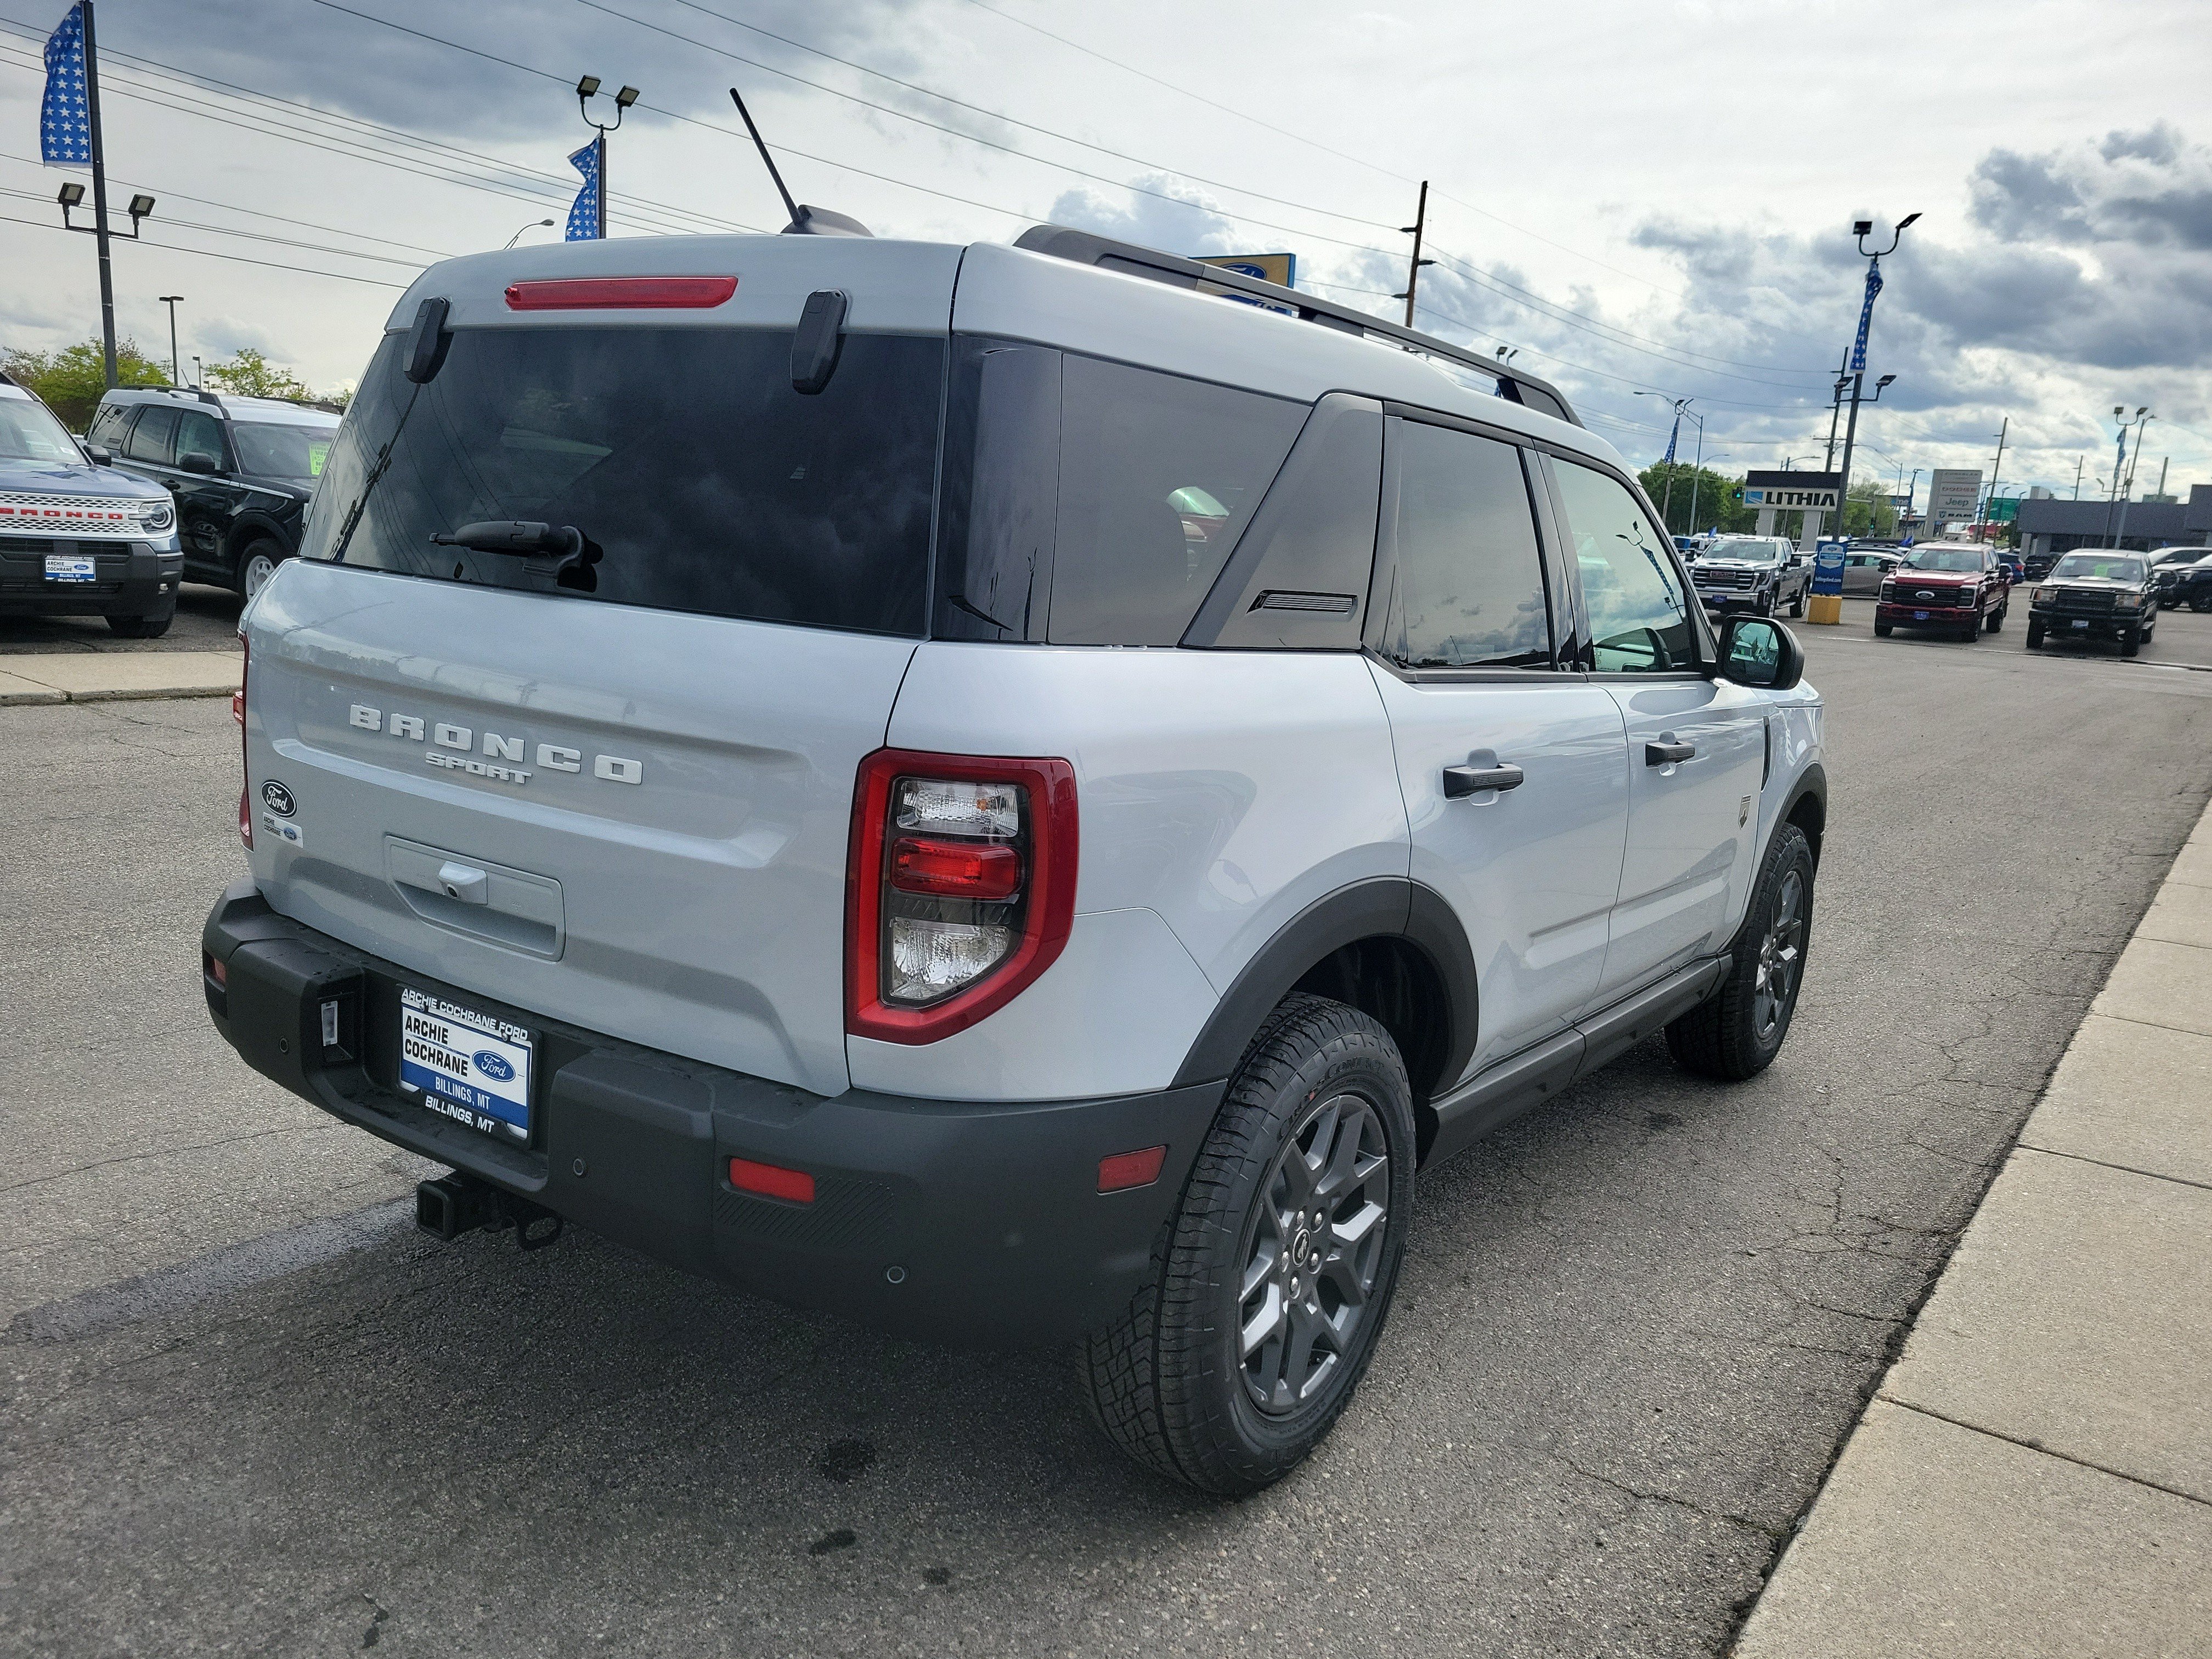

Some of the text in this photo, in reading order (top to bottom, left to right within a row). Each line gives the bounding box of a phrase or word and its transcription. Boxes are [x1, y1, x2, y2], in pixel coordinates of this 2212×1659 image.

[0, 507, 123, 520] BRONCO
[1765, 492, 1835, 506] LITHIA
[1946, 498, 1968, 506] Jeep
[349, 704, 643, 785] BRONCO
[425, 752, 532, 784] SPORT
[402, 988, 528, 1041] ARCHIE COCHRANE FORD
[405, 1015, 449, 1045] ARCHIE
[405, 1039, 469, 1077] COCHRANE
[435, 1076, 490, 1110] BILLINGS, MT
[425, 1095, 494, 1133] BILLINGS, MT
